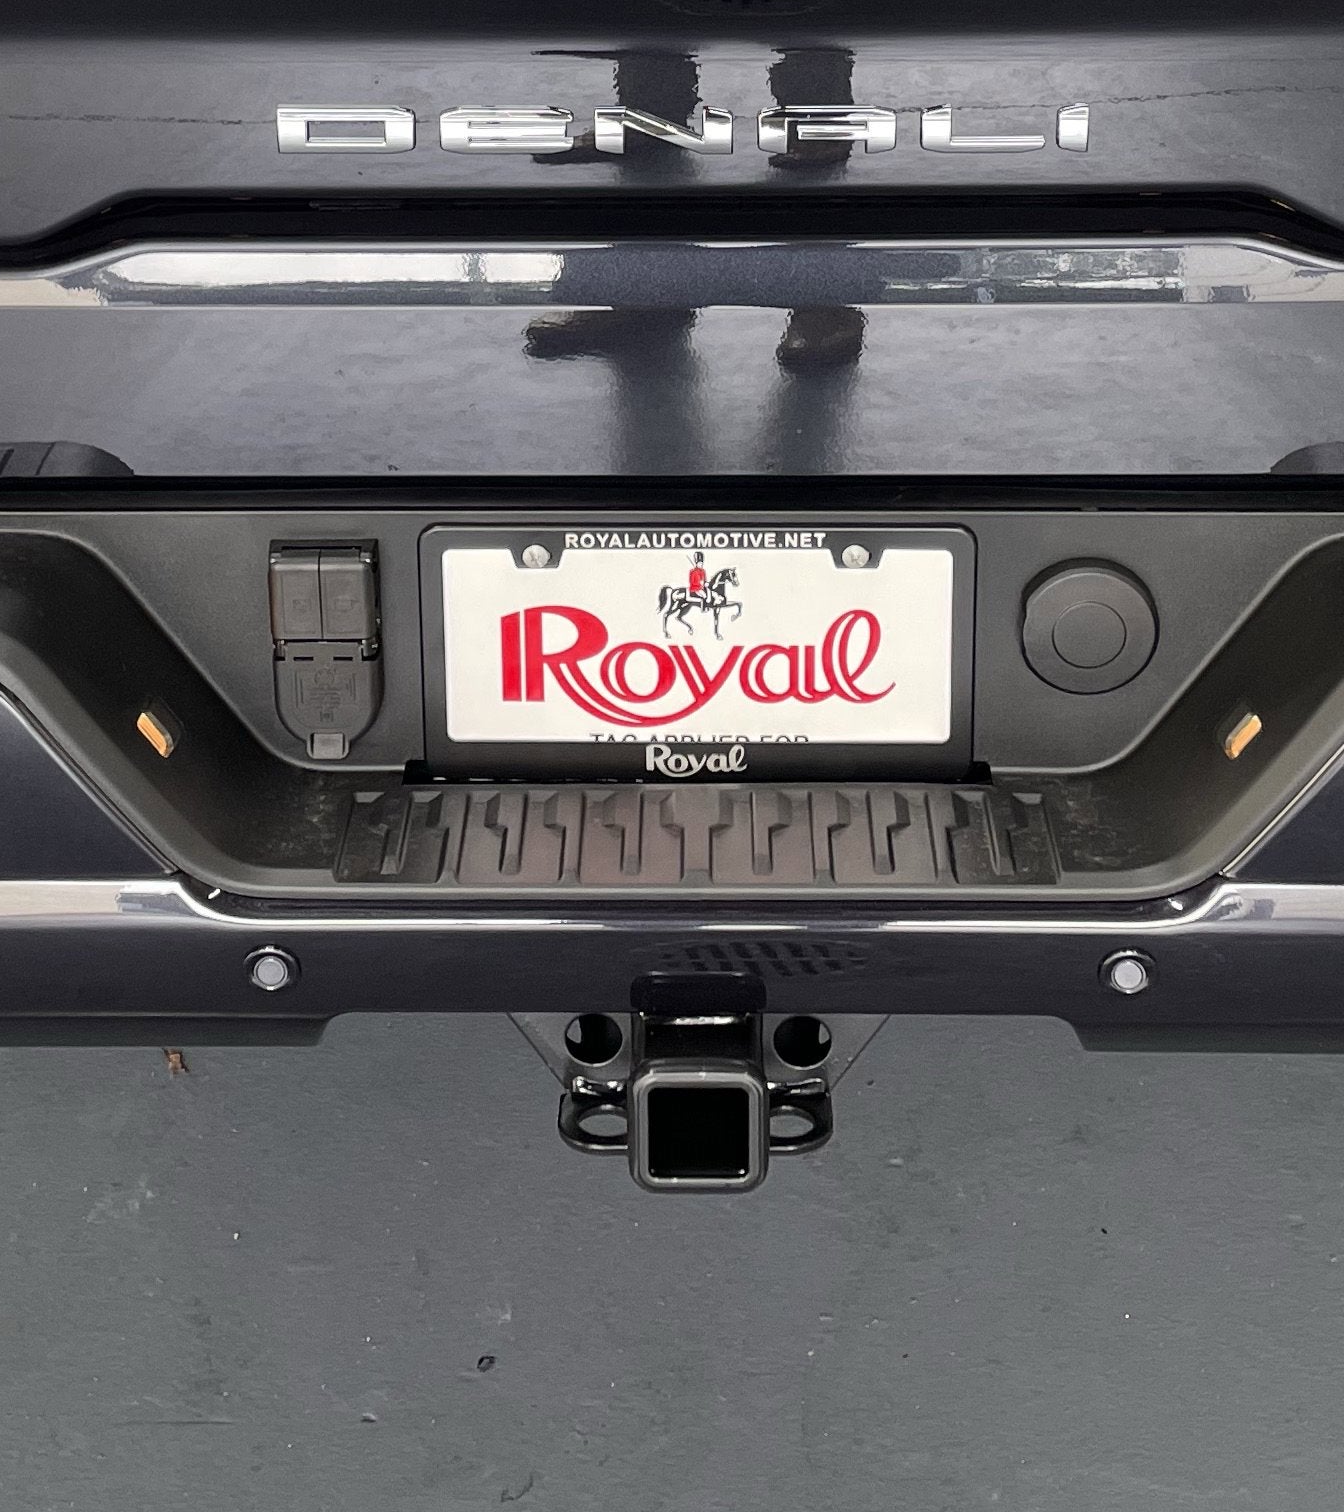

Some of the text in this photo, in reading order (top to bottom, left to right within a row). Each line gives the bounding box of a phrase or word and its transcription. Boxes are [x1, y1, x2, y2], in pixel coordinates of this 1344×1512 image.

[276, 101, 1090, 155] DENALI
[564, 532, 827, 549] ROYALAUTOMOTIVE.NET
[501, 605, 896, 727] Royal
[645, 743, 748, 778] Royal
